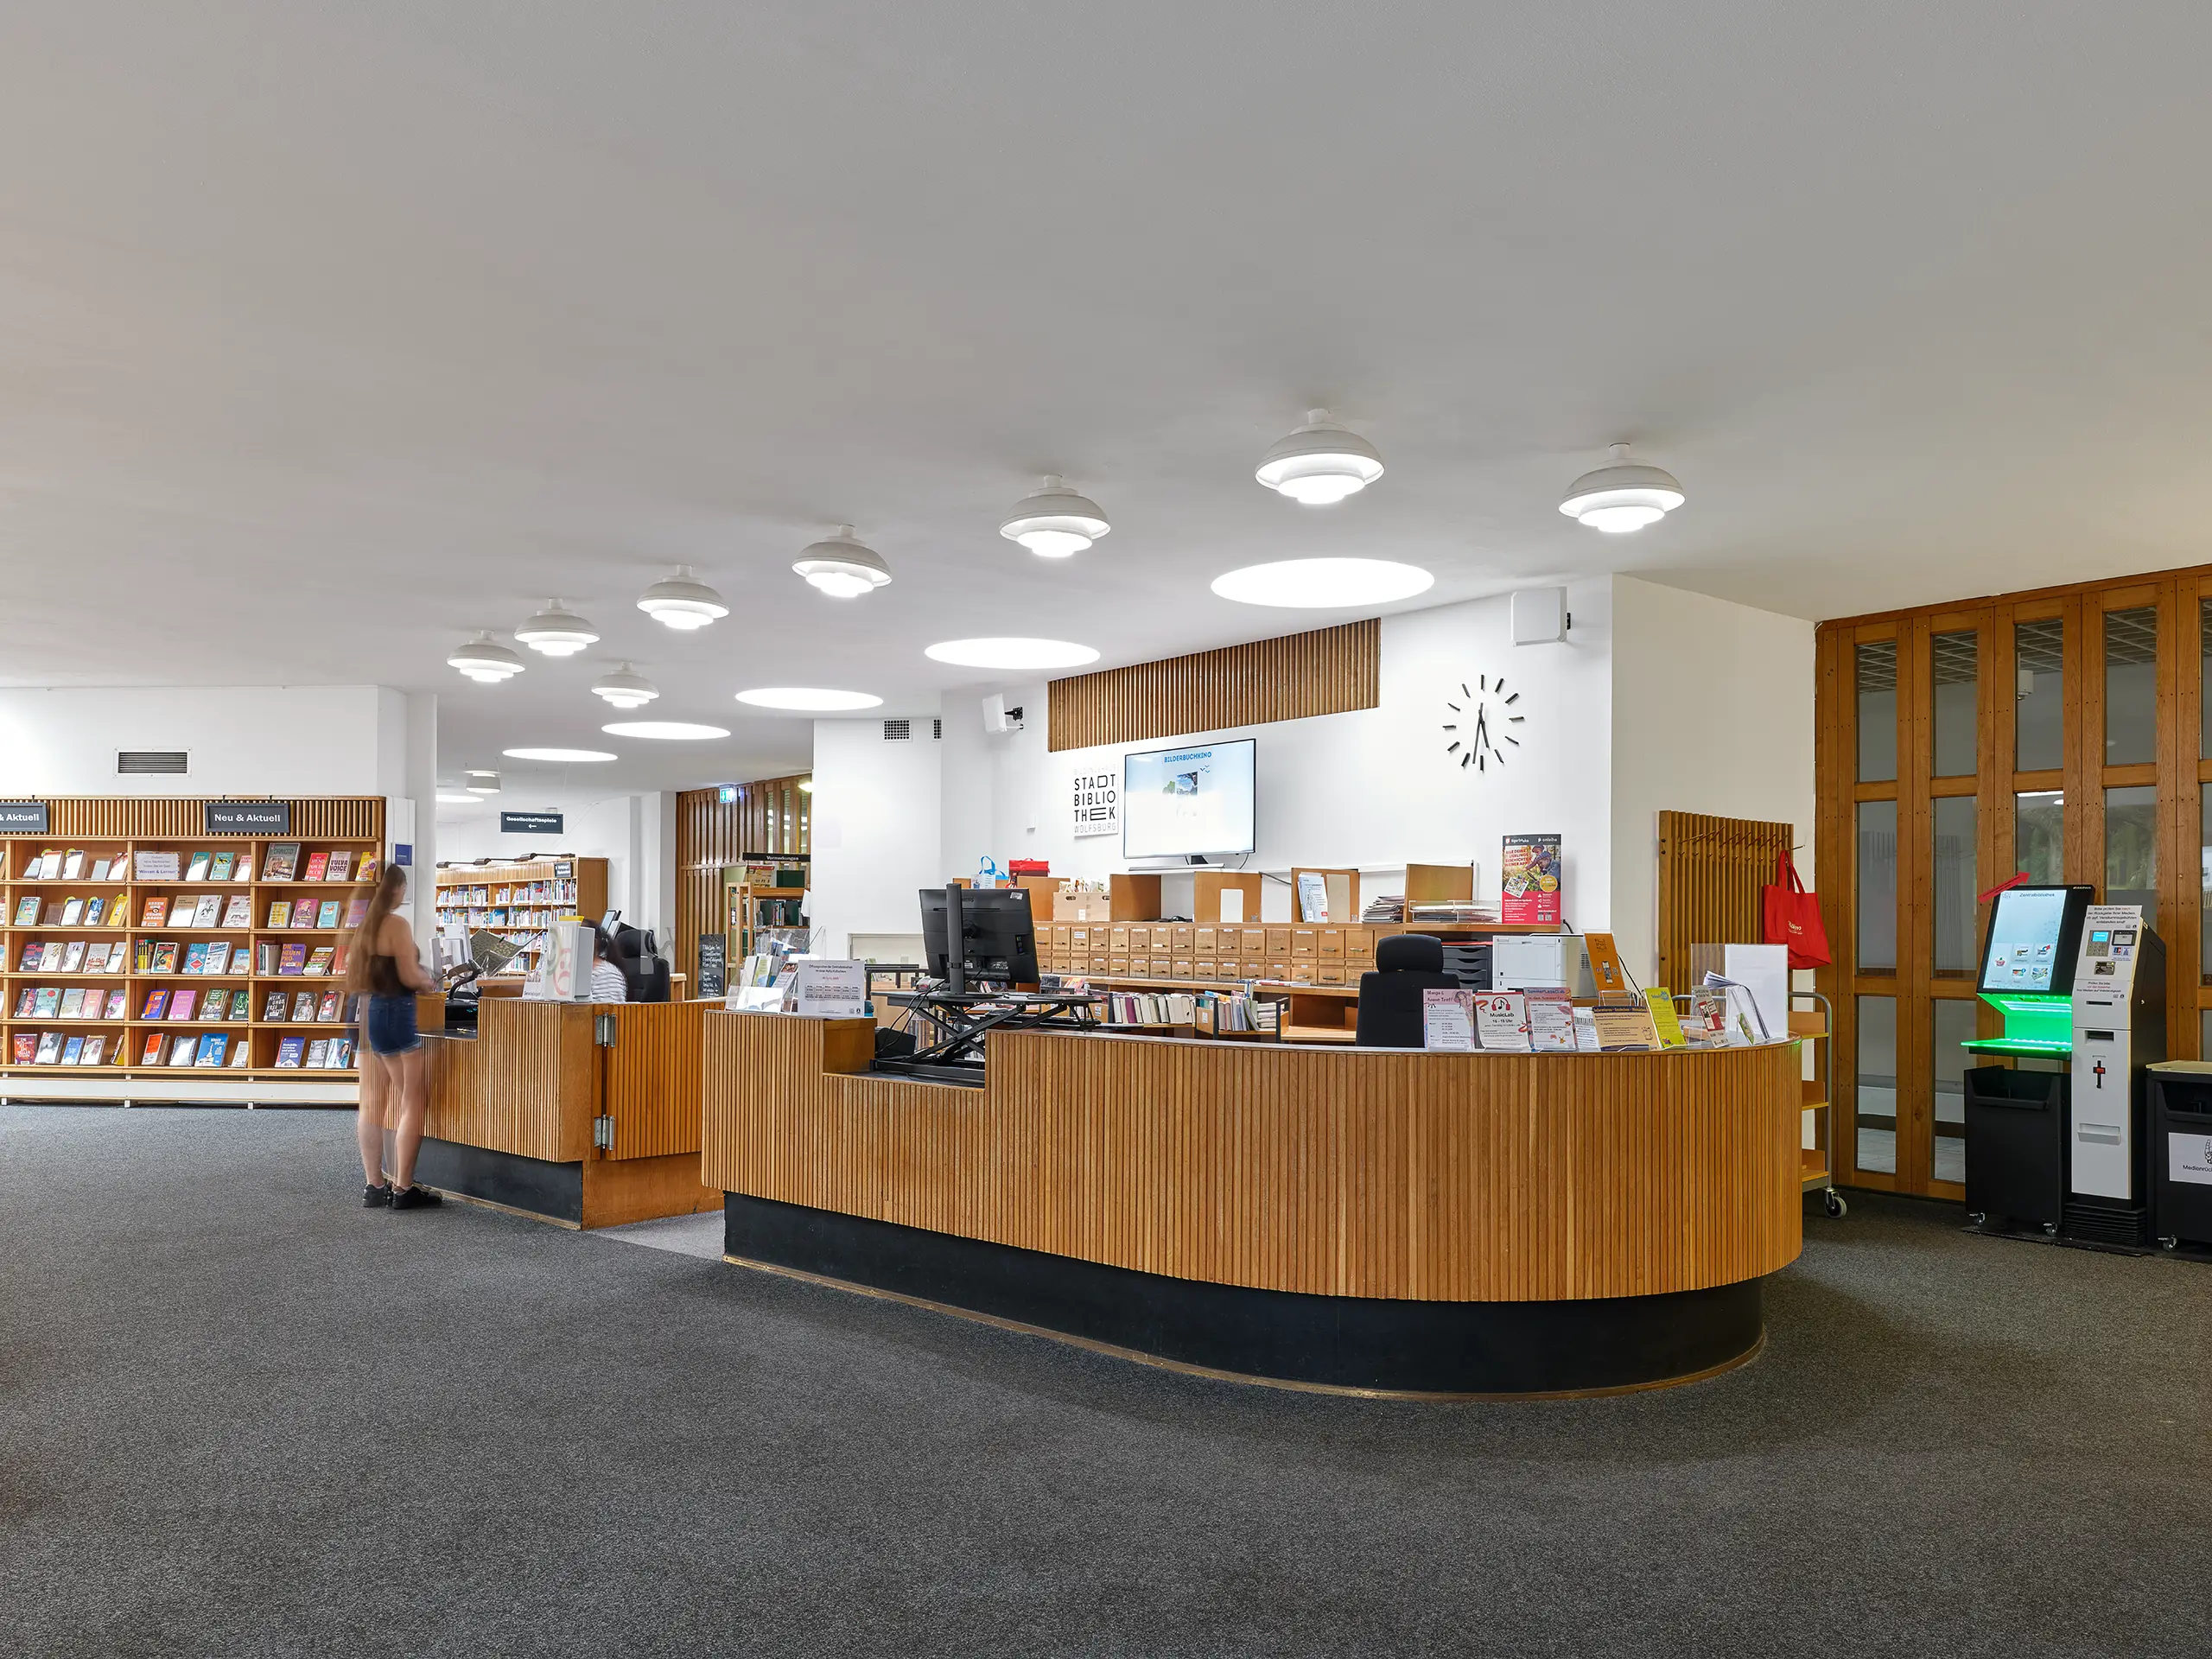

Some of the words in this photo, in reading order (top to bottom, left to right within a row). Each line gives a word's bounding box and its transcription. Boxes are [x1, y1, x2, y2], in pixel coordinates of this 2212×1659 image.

[1164, 751, 1212, 763] BILDERBUCHKINO
[1074, 773, 1116, 791] STADT
[1074, 790, 1116, 806] BIBLIO
[6, 813, 40, 822] Aktuell
[214, 813, 233, 822] Neu
[236, 813, 244, 822] &
[1074, 806, 1116, 823] THEK
[1074, 822, 1116, 833] WOLFSBURG
[2183, 1164, 2212, 1173] Medienrüc
